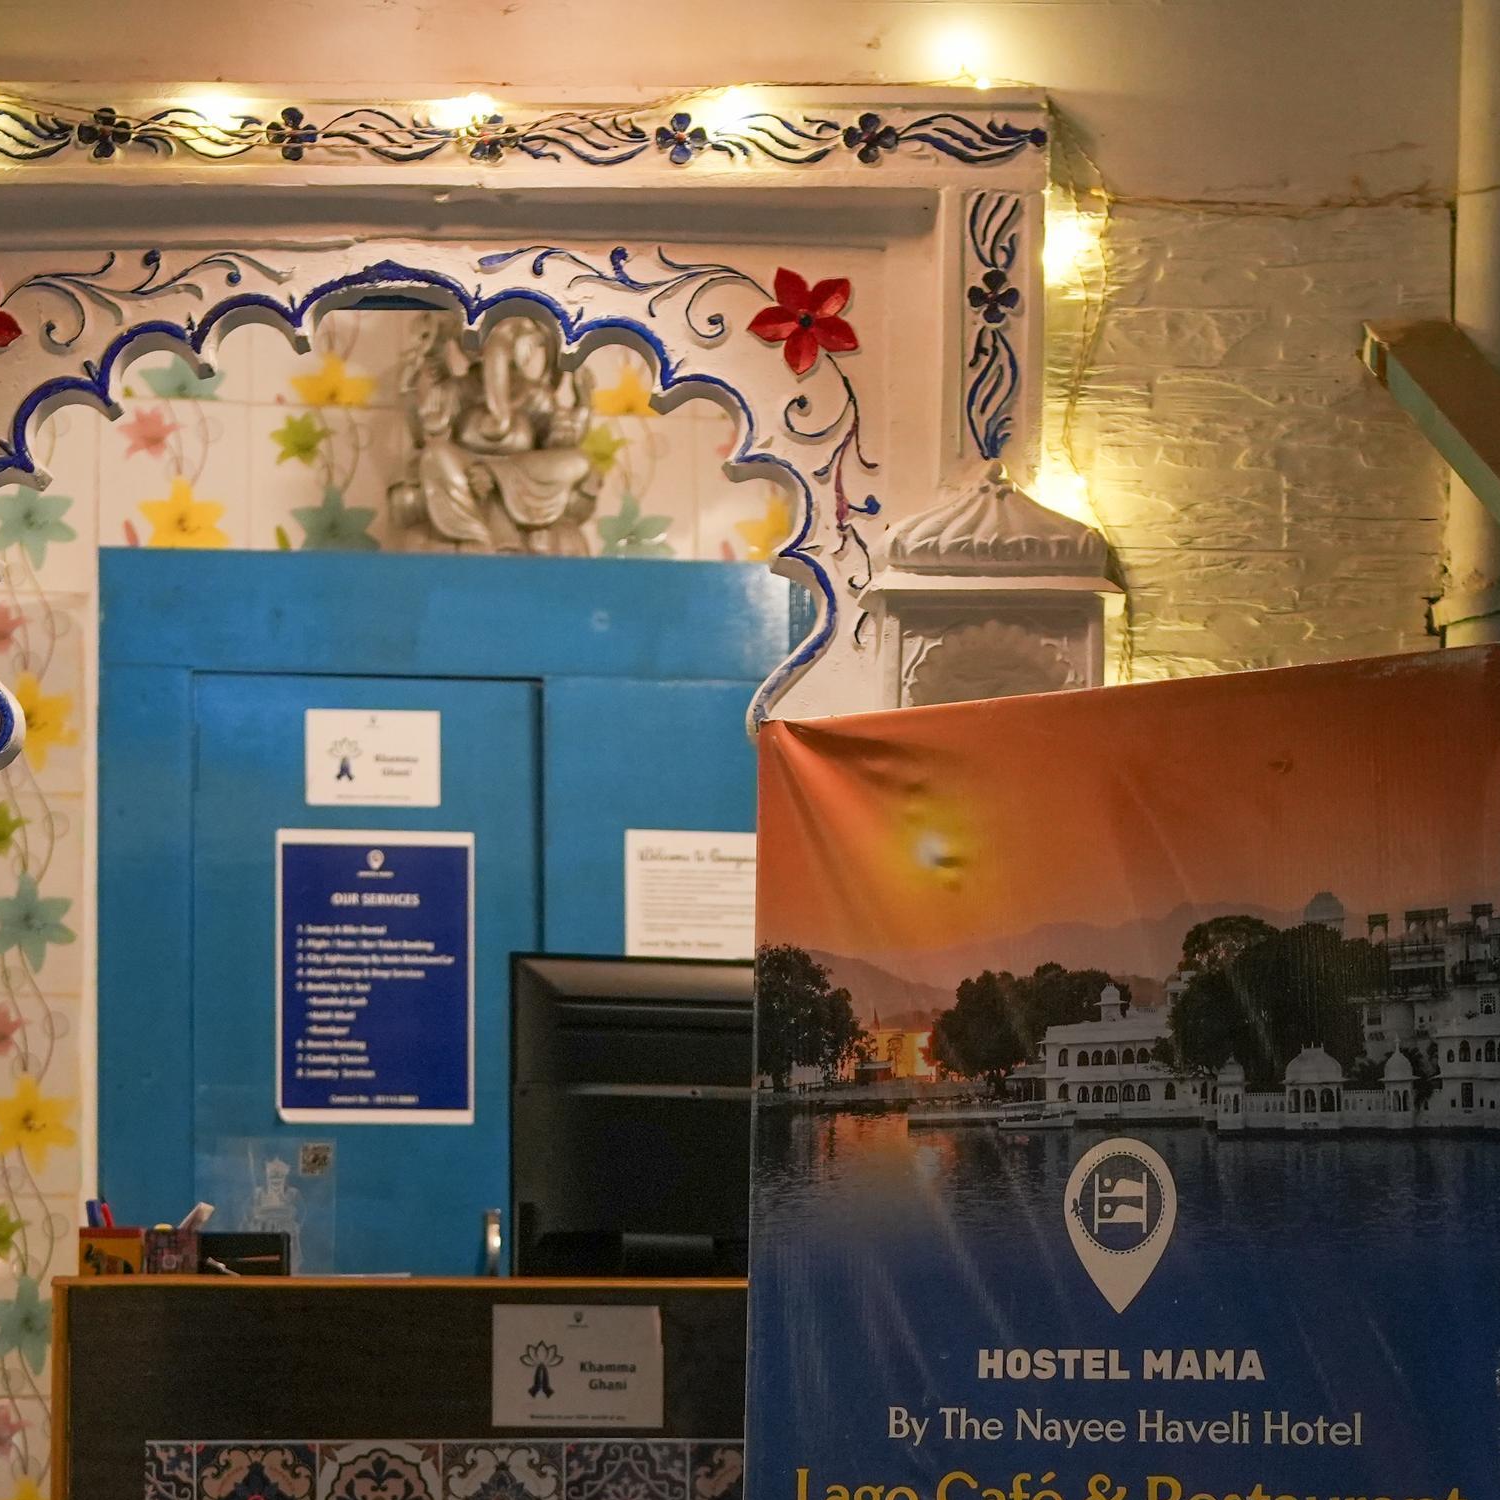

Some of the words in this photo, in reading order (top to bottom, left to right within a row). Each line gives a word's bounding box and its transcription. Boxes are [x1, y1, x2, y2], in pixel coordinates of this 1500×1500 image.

[331, 892, 360, 906] OUR
[361, 893, 420, 907] SERVICES
[580, 1361, 636, 1373] Khamma
[978, 1348, 1130, 1381] HOSTEL
[1143, 1349, 1265, 1381] MAMA
[589, 1379, 627, 1390] Ghani
[888, 1406, 931, 1446] By
[939, 1407, 1004, 1441] The
[1016, 1409, 1125, 1448] Nayee
[1138, 1410, 1249, 1445] Haveli
[1264, 1412, 1362, 1446] Hotel
